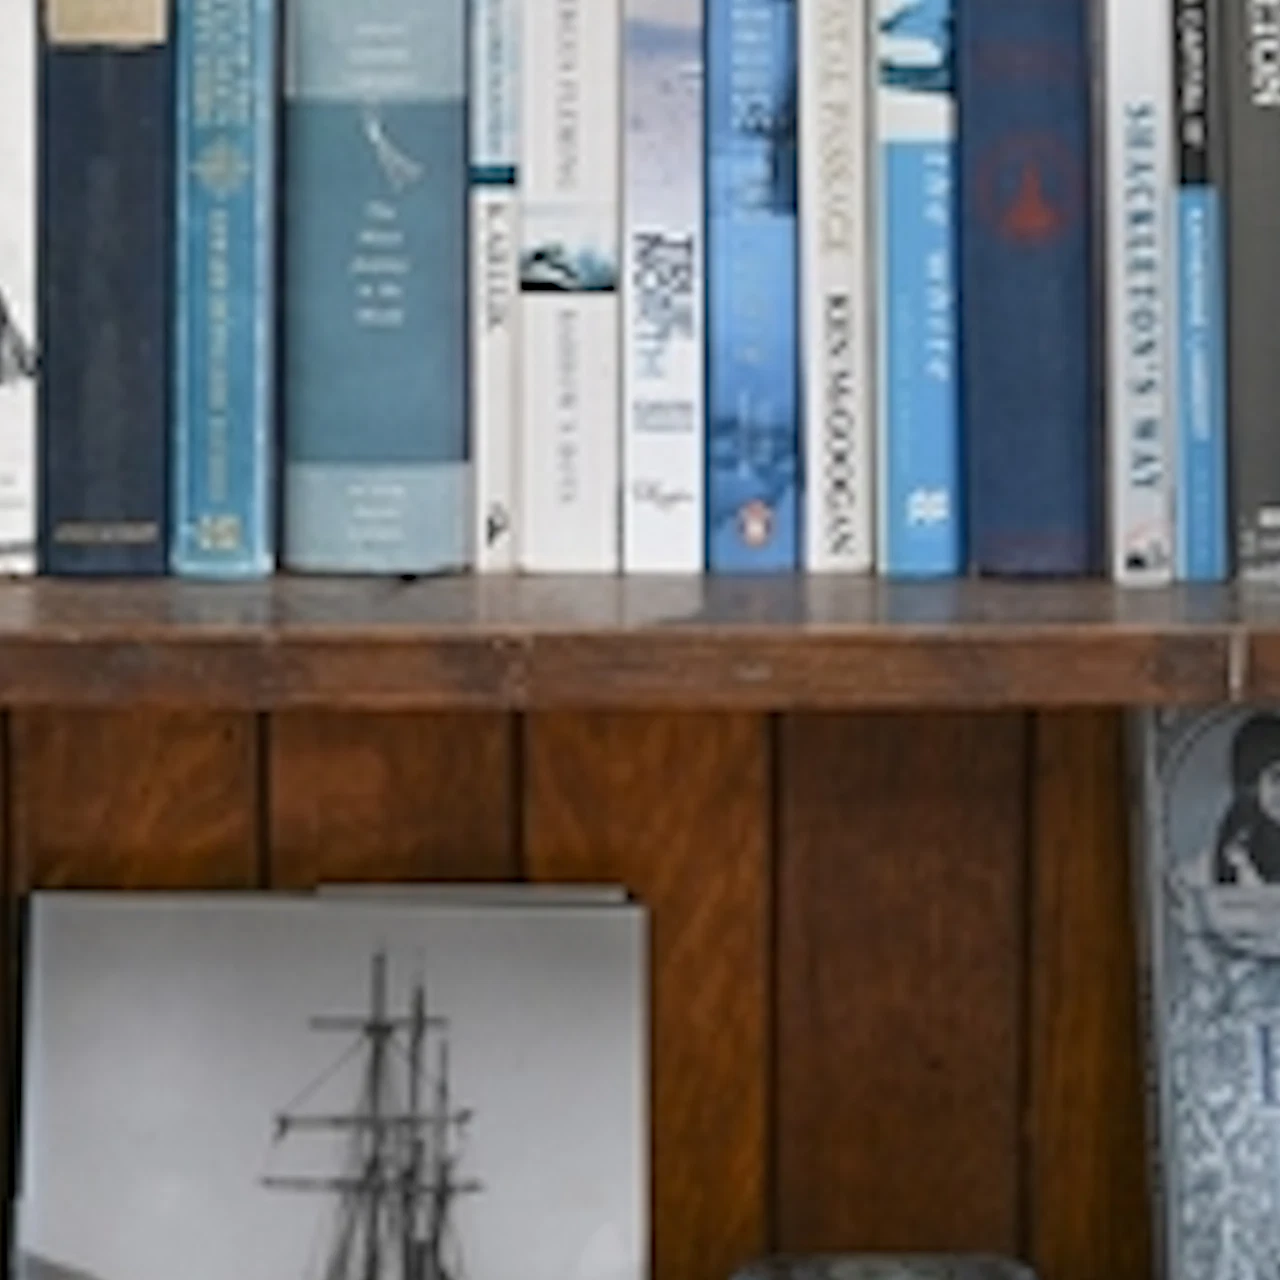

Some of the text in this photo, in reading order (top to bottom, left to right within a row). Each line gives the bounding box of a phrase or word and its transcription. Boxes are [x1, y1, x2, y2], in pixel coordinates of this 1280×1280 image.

[555, 79, 580, 191] FLEMING
[632, 233, 663, 378] NORTH
[825, 293, 855, 356] KEN
[1124, 102, 1163, 490] SHACKLETON'S WAY
